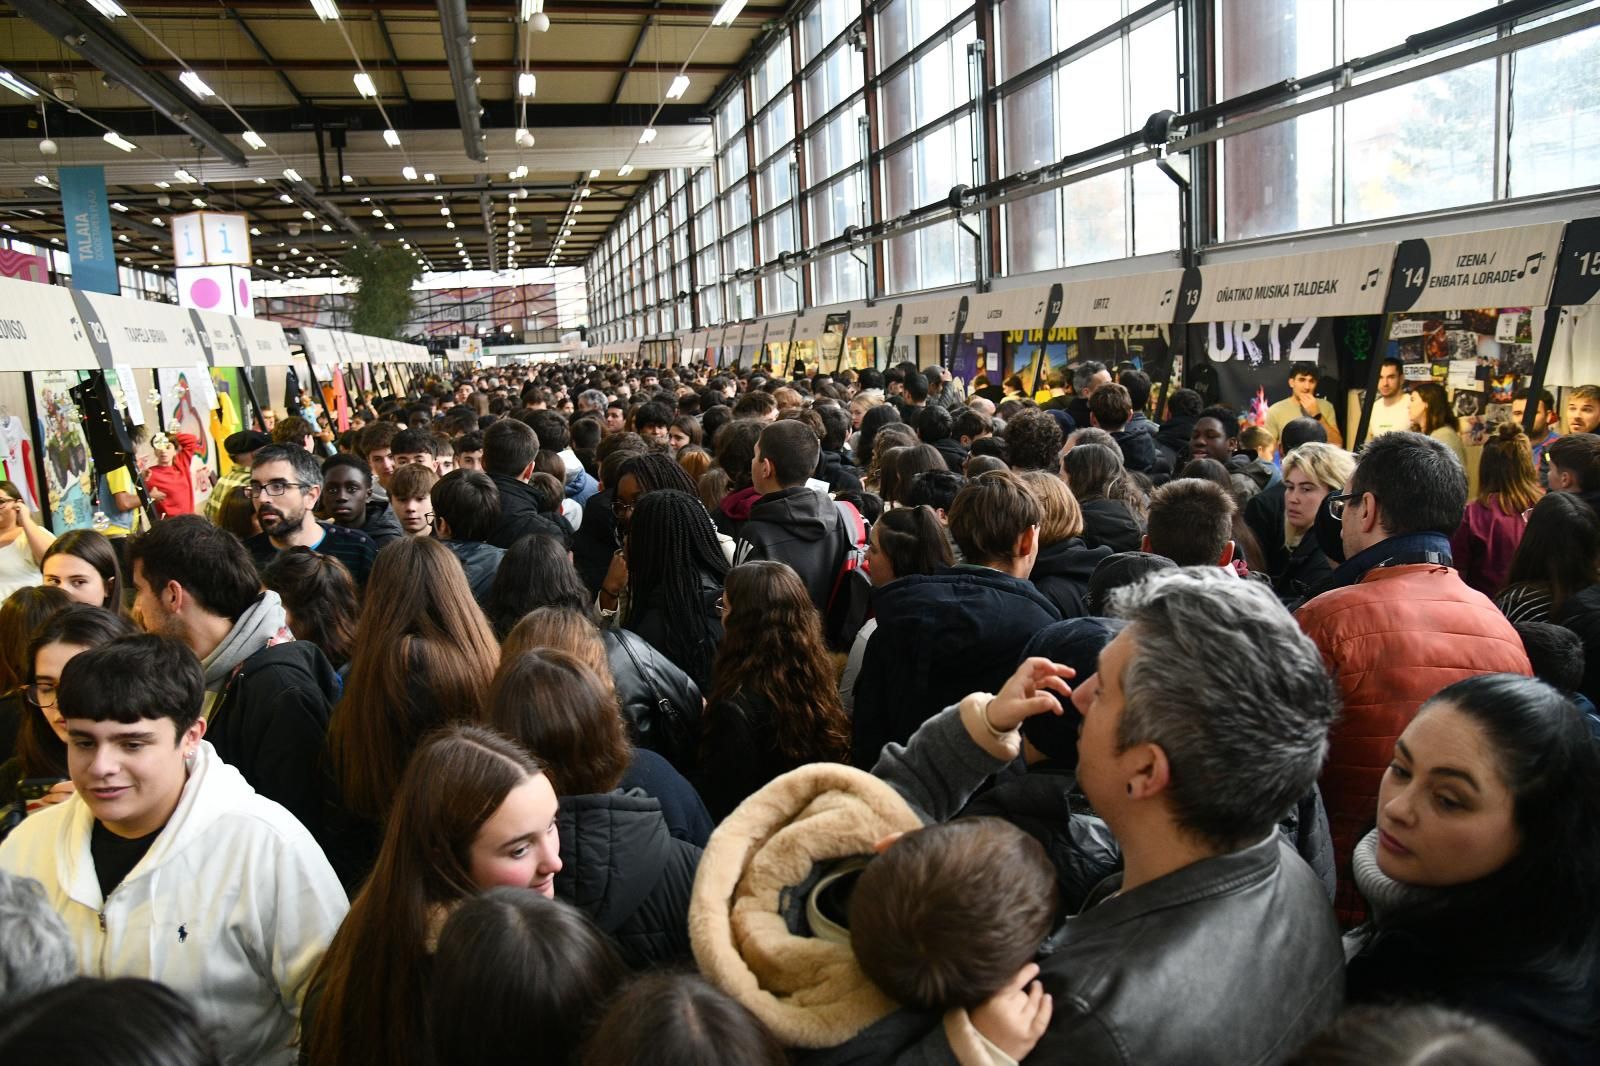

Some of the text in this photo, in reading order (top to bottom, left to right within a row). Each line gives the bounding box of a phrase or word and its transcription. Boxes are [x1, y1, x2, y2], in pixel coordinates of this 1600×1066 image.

[75, 212, 94, 262] TALAIA
[1456, 251, 1497, 268] IZENA /
[1429, 269, 1518, 288] ENBATA LORADE
[1186, 289, 1199, 306] 13
[1216, 279, 1339, 303] OÑATIKO MUSIKA TALDEAK
[1052, 300, 1061, 314] 12
[1093, 297, 1110, 309] URTZ
[1207, 317, 1319, 363] URTZ
